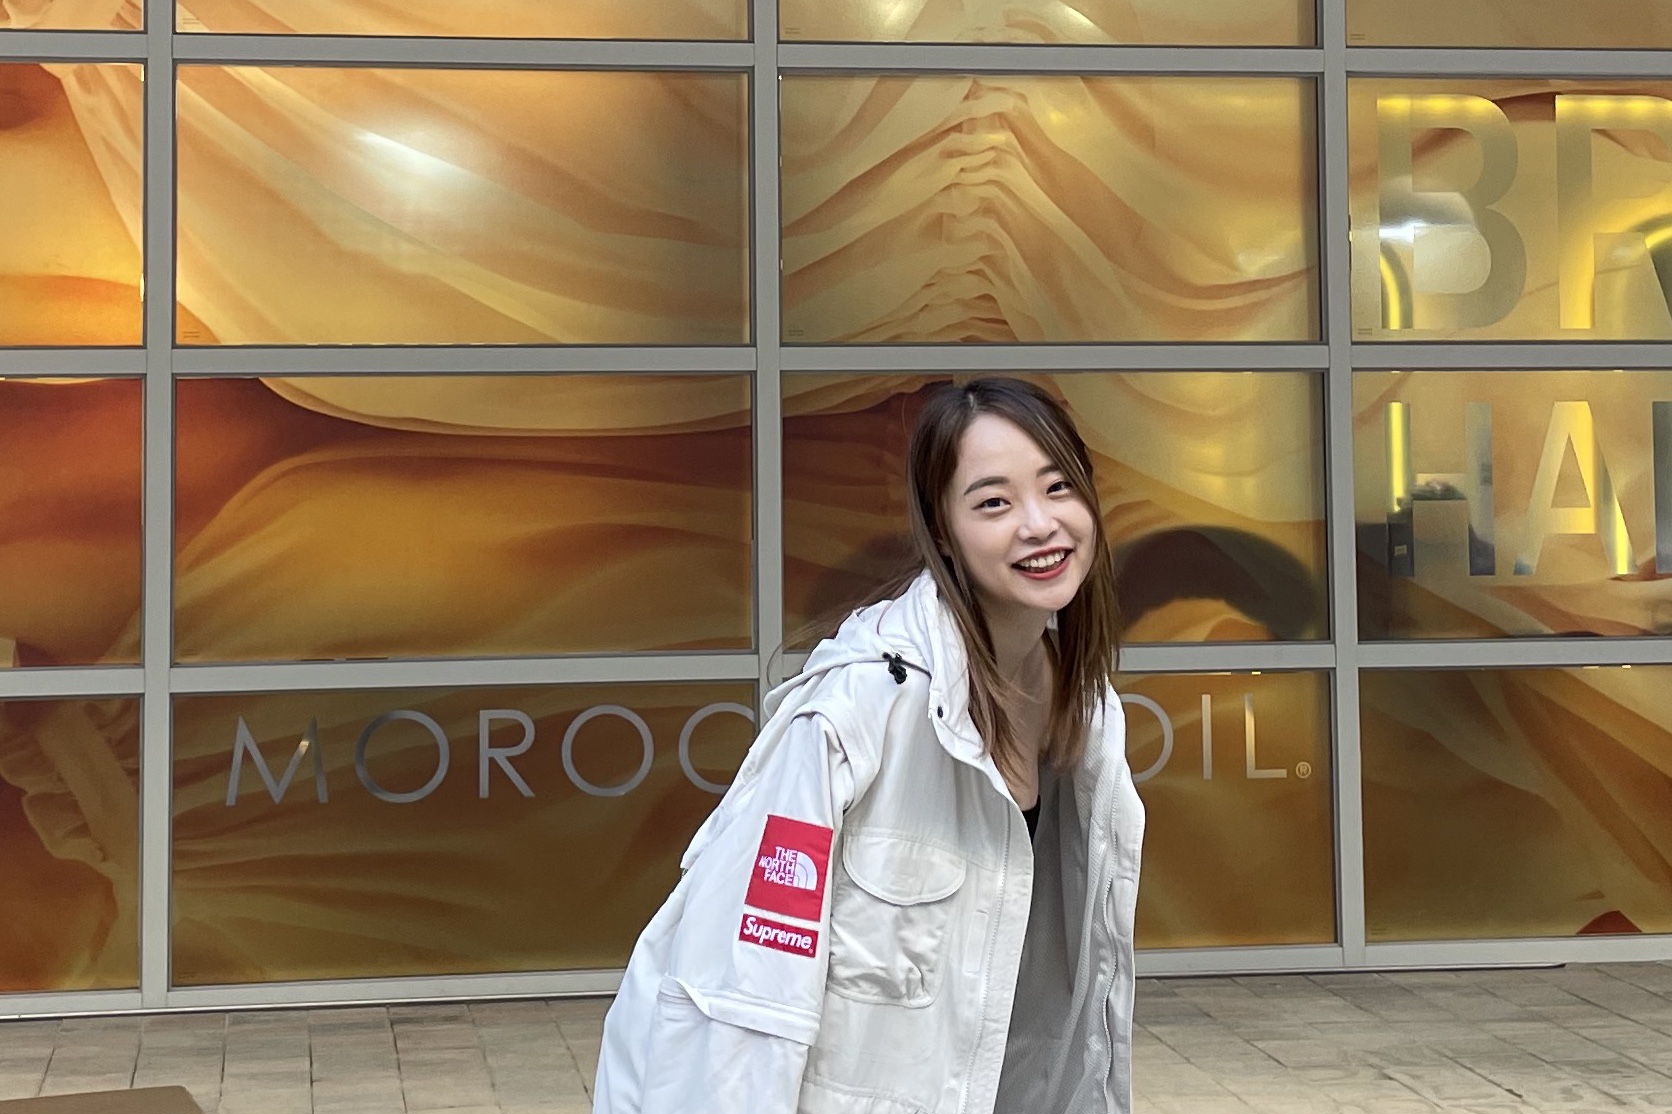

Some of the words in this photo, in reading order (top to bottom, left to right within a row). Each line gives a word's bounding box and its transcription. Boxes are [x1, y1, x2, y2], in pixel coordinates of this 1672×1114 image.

[774, 846, 798, 862] THE
[758, 856, 795, 875] NORTH
[763, 868, 794, 887] FACE
[743, 916, 813, 950] Supreme
